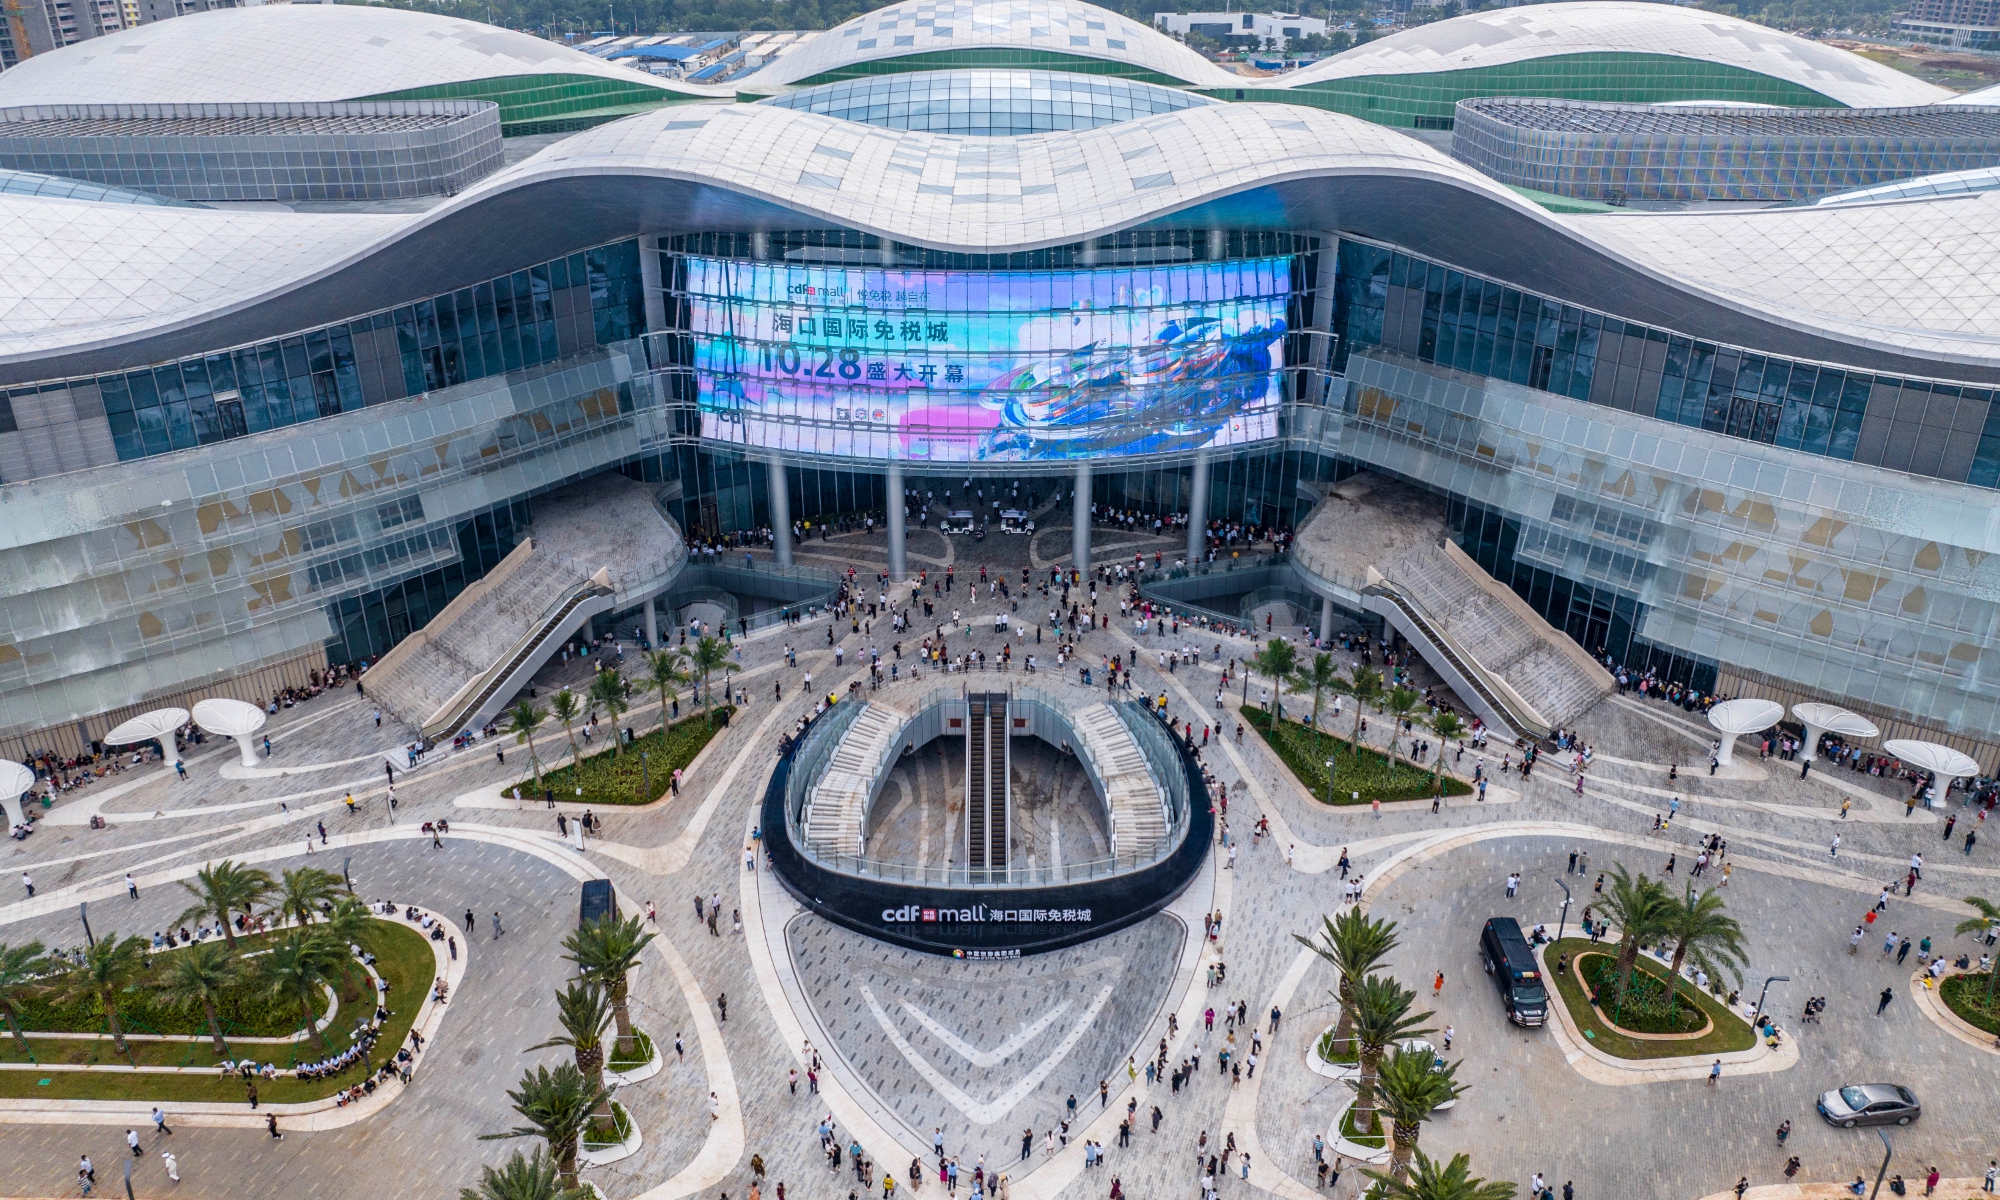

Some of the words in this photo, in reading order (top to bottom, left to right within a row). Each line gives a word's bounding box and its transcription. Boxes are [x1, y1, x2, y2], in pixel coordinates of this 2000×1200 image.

[787, 283, 808, 295] cdf
[818, 286, 845, 299] mall
[773, 313, 949, 342] 海口国际免税城
[758, 343, 862, 380] 10.28
[868, 362, 964, 383] 盛大开幕
[881, 905, 920, 922] cdf
[938, 905, 985, 922] mall
[989, 909, 1092, 922] 海口国际免税城
